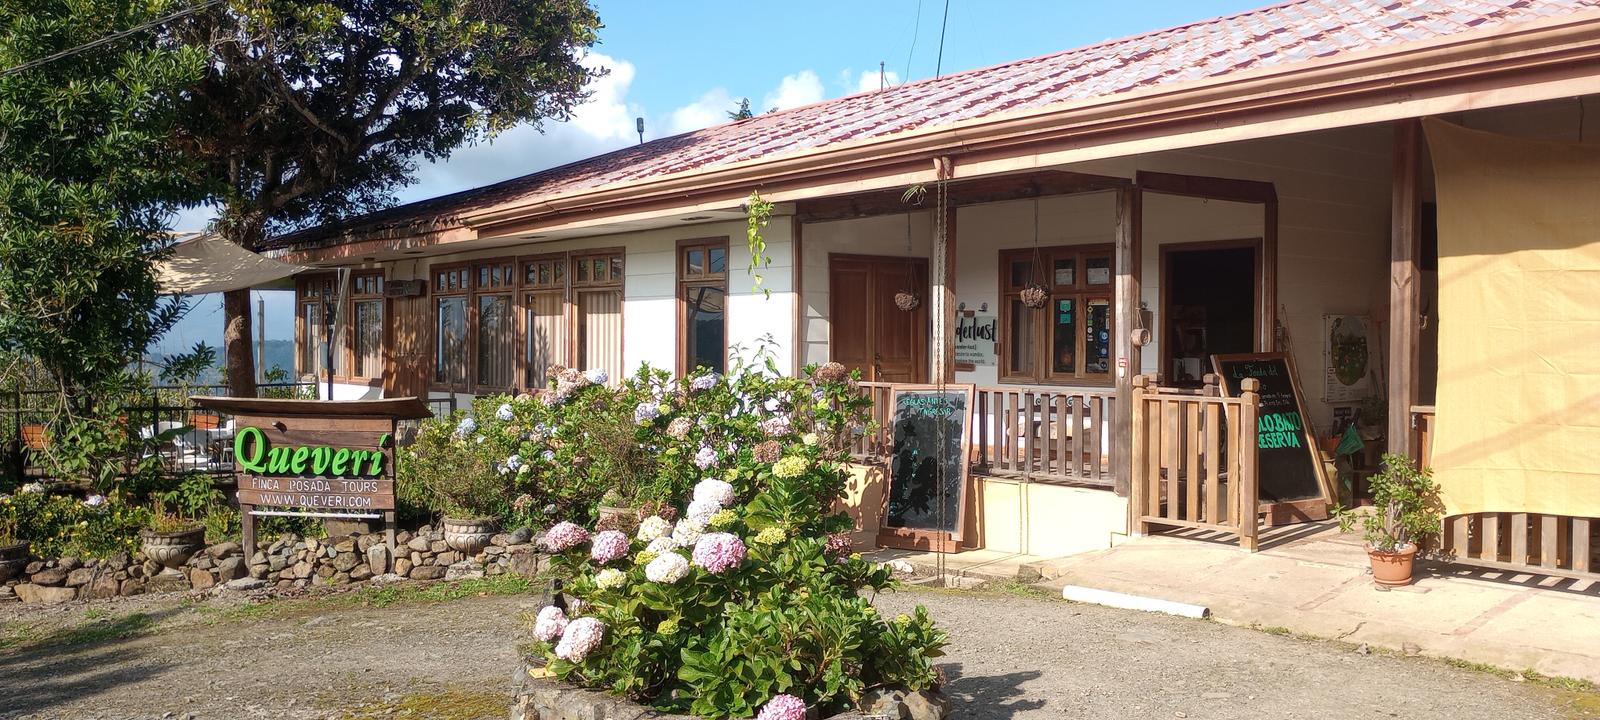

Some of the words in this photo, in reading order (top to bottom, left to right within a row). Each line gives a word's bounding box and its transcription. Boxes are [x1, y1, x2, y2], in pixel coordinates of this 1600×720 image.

[954, 317, 997, 342] derlust
[234, 425, 390, 477] Queverí
[252, 477, 280, 490] FINCA
[289, 479, 331, 492] POSADA
[342, 480, 378, 493] TOURS
[260, 493, 371, 507] WWW.QUEVERI.COM
